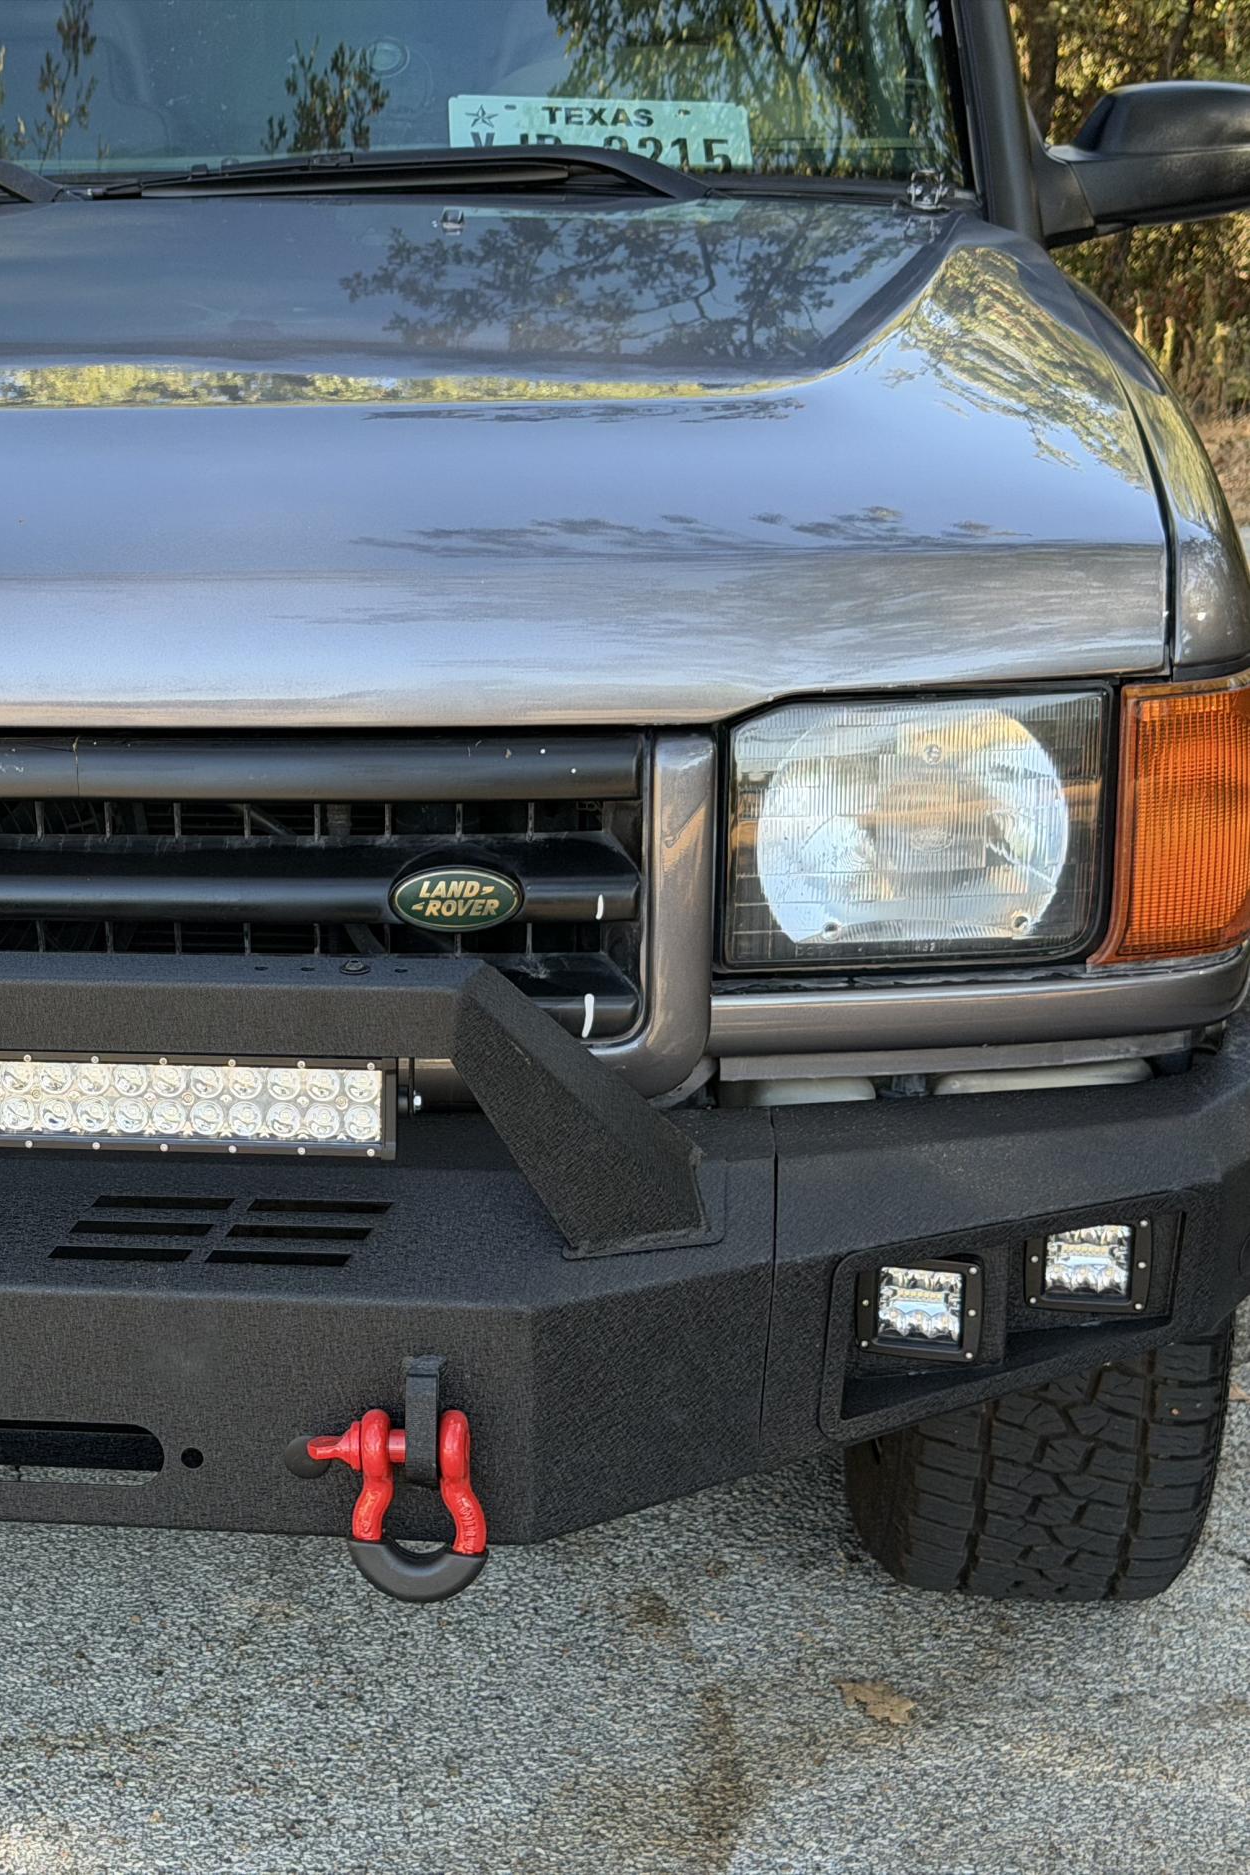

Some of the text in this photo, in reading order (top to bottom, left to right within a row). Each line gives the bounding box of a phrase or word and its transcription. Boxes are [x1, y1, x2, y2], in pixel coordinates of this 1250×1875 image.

[541, 106, 654, 127] TEXAS
[419, 880, 480, 898] LAND
[424, 899, 500, 917] ROVER
